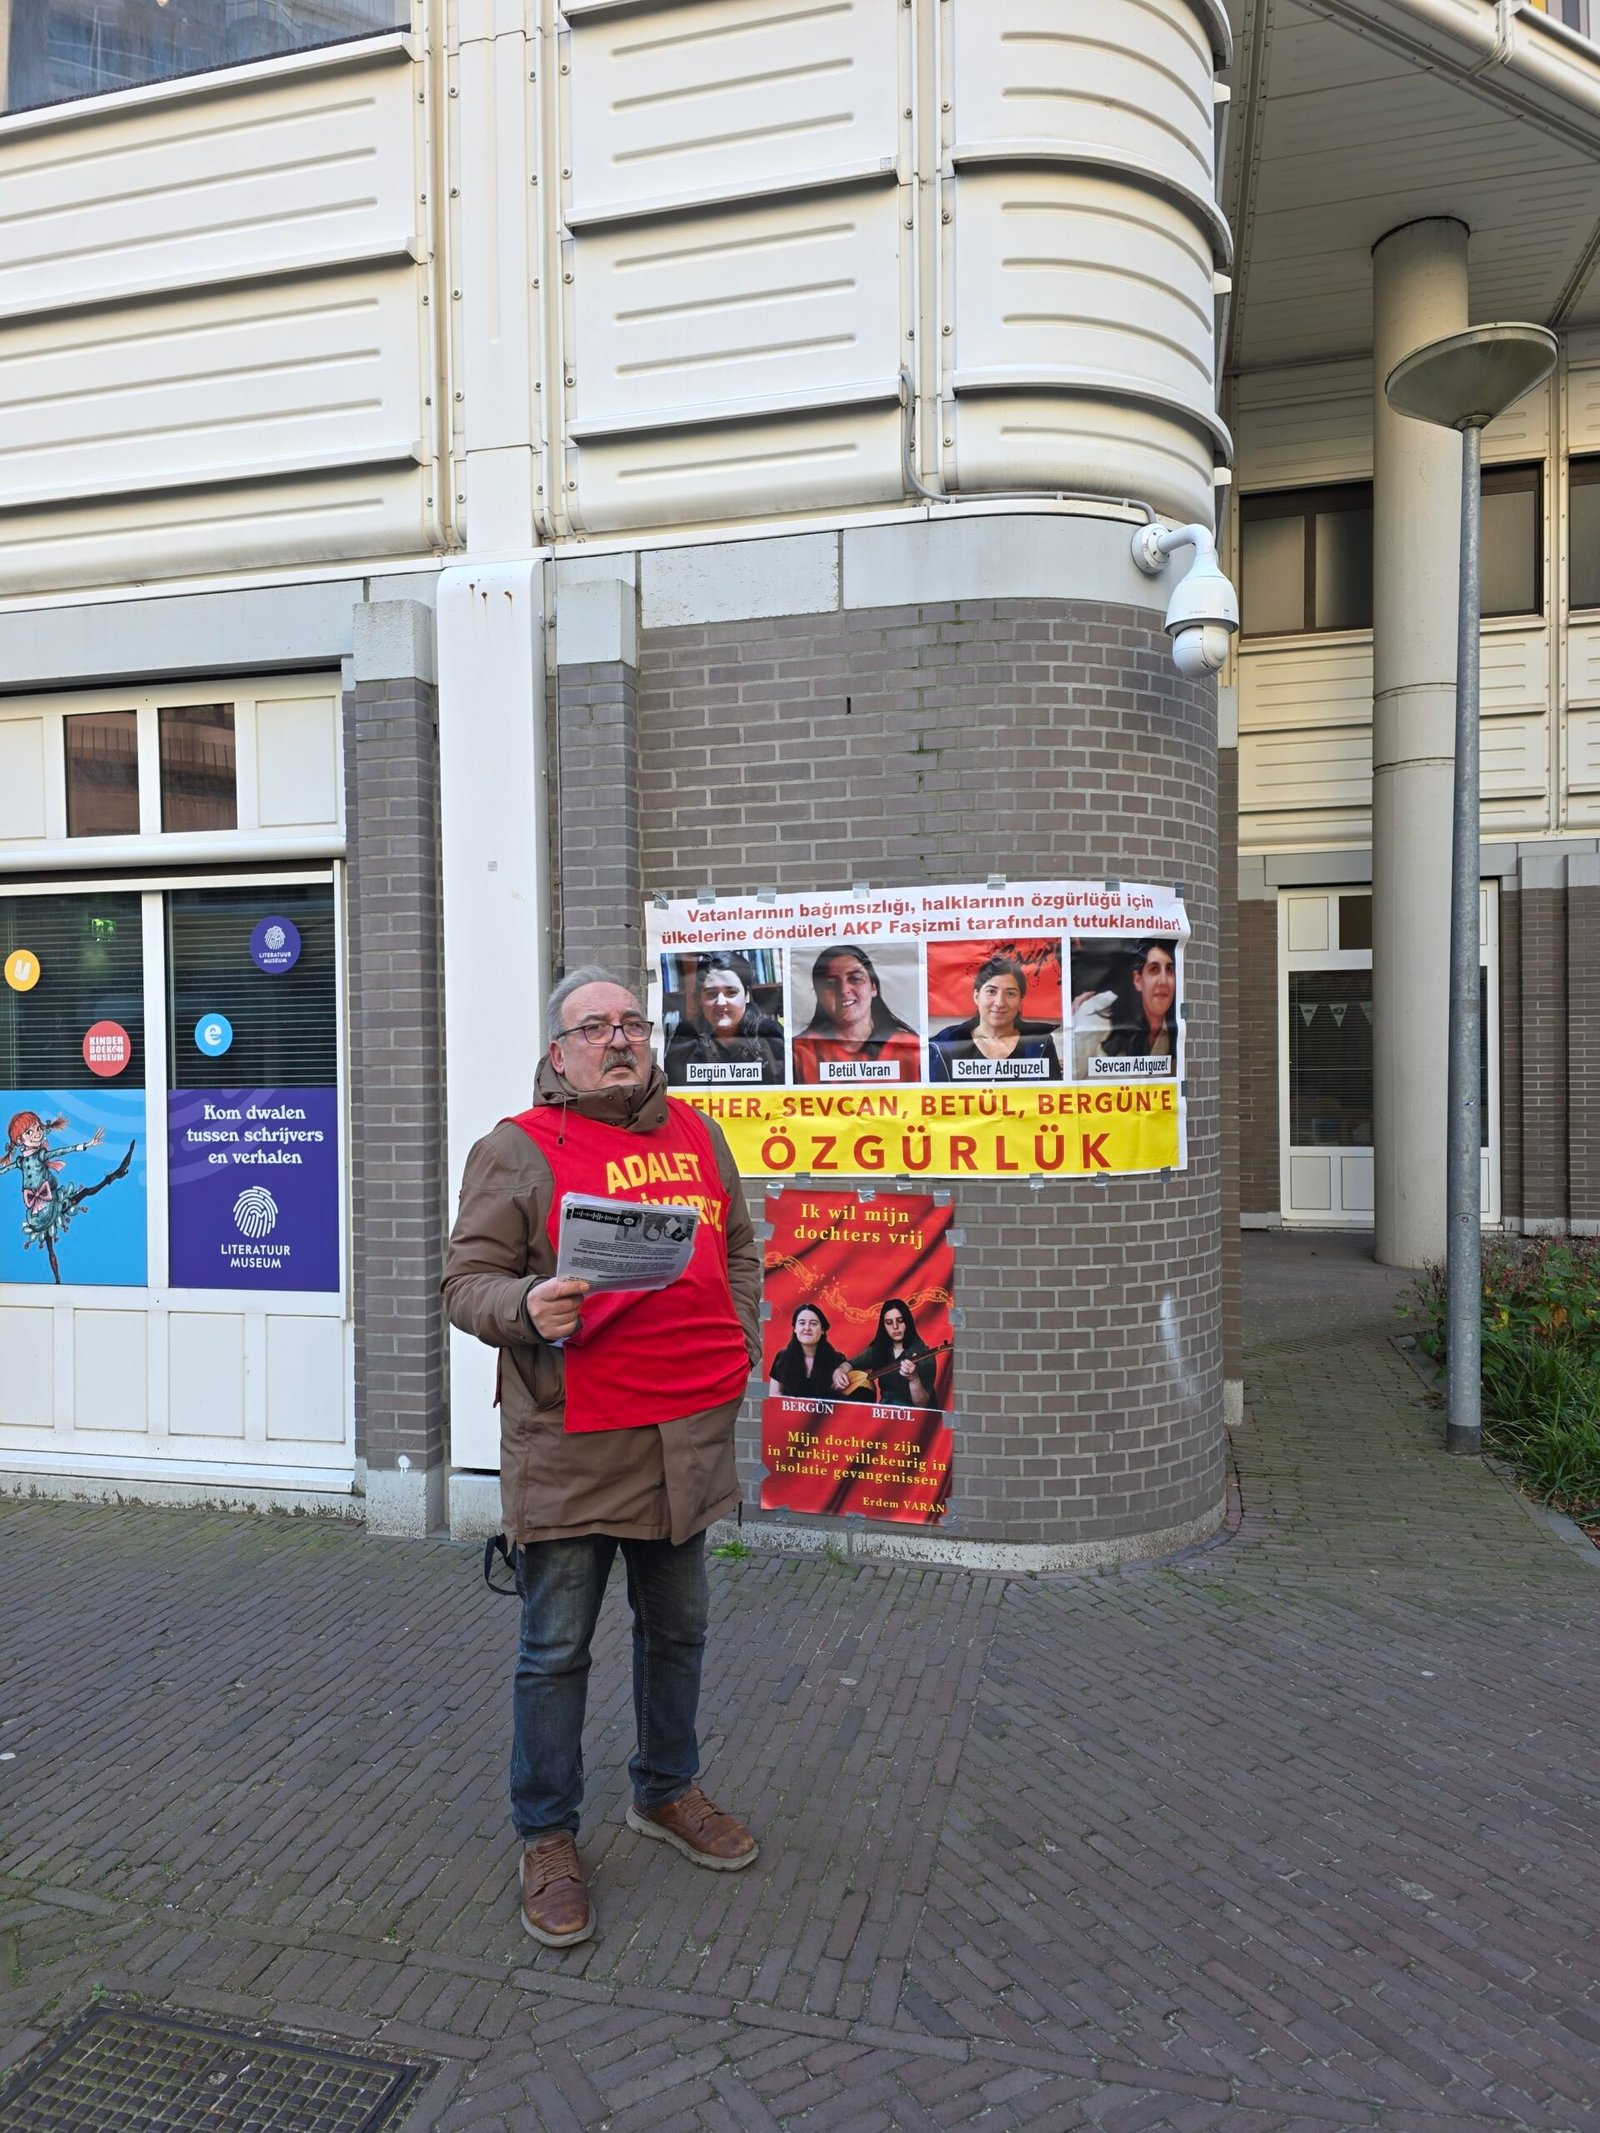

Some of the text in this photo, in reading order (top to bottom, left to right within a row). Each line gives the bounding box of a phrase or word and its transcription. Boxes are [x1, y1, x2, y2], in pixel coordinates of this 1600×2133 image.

[687, 892, 1154, 923] Vatanlarının bağımsızlığı, halklarının özgürlüğü için
[661, 914, 1181, 945] ülkelerine döndüler! AKP Faşizmi tarafından tutuklandılar!
[258, 951, 292, 959] LITERATUUR
[89, 1053, 124, 1062] MUSEUM
[1095, 1059, 1131, 1073] Sevcan
[690, 1064, 760, 1081] Bergün Varan
[828, 1063, 891, 1077] Betül Varan
[957, 1060, 992, 1075] Seher
[203, 1104, 306, 1120] Kom dwalen
[678, 1097, 771, 1120] EHER,
[782, 1096, 908, 1119] SEVCAN,
[921, 1089, 1025, 1119] BETÜL,
[186, 1127, 324, 1145] tussen schrijvers
[208, 1149, 302, 1164] en verhalen
[761, 1124, 1112, 1171] ÖZGÜRLÜK
[606, 1152, 702, 1195] ADALET
[801, 1203, 910, 1227] Ik wil mijn
[794, 1224, 924, 1250] dochters vrij
[220, 1244, 291, 1256] LITERATUUR
[230, 1257, 282, 1269] MUSEUM
[781, 1400, 915, 1422] BERGÜN BETÜL
[787, 1431, 921, 1456] Mijn dochters zijn
[767, 1445, 946, 1472] in Turkije willekeurig in
[775, 1461, 938, 1486] isolatie gevangenissen
[863, 1496, 945, 1513] Erdem VARAN
